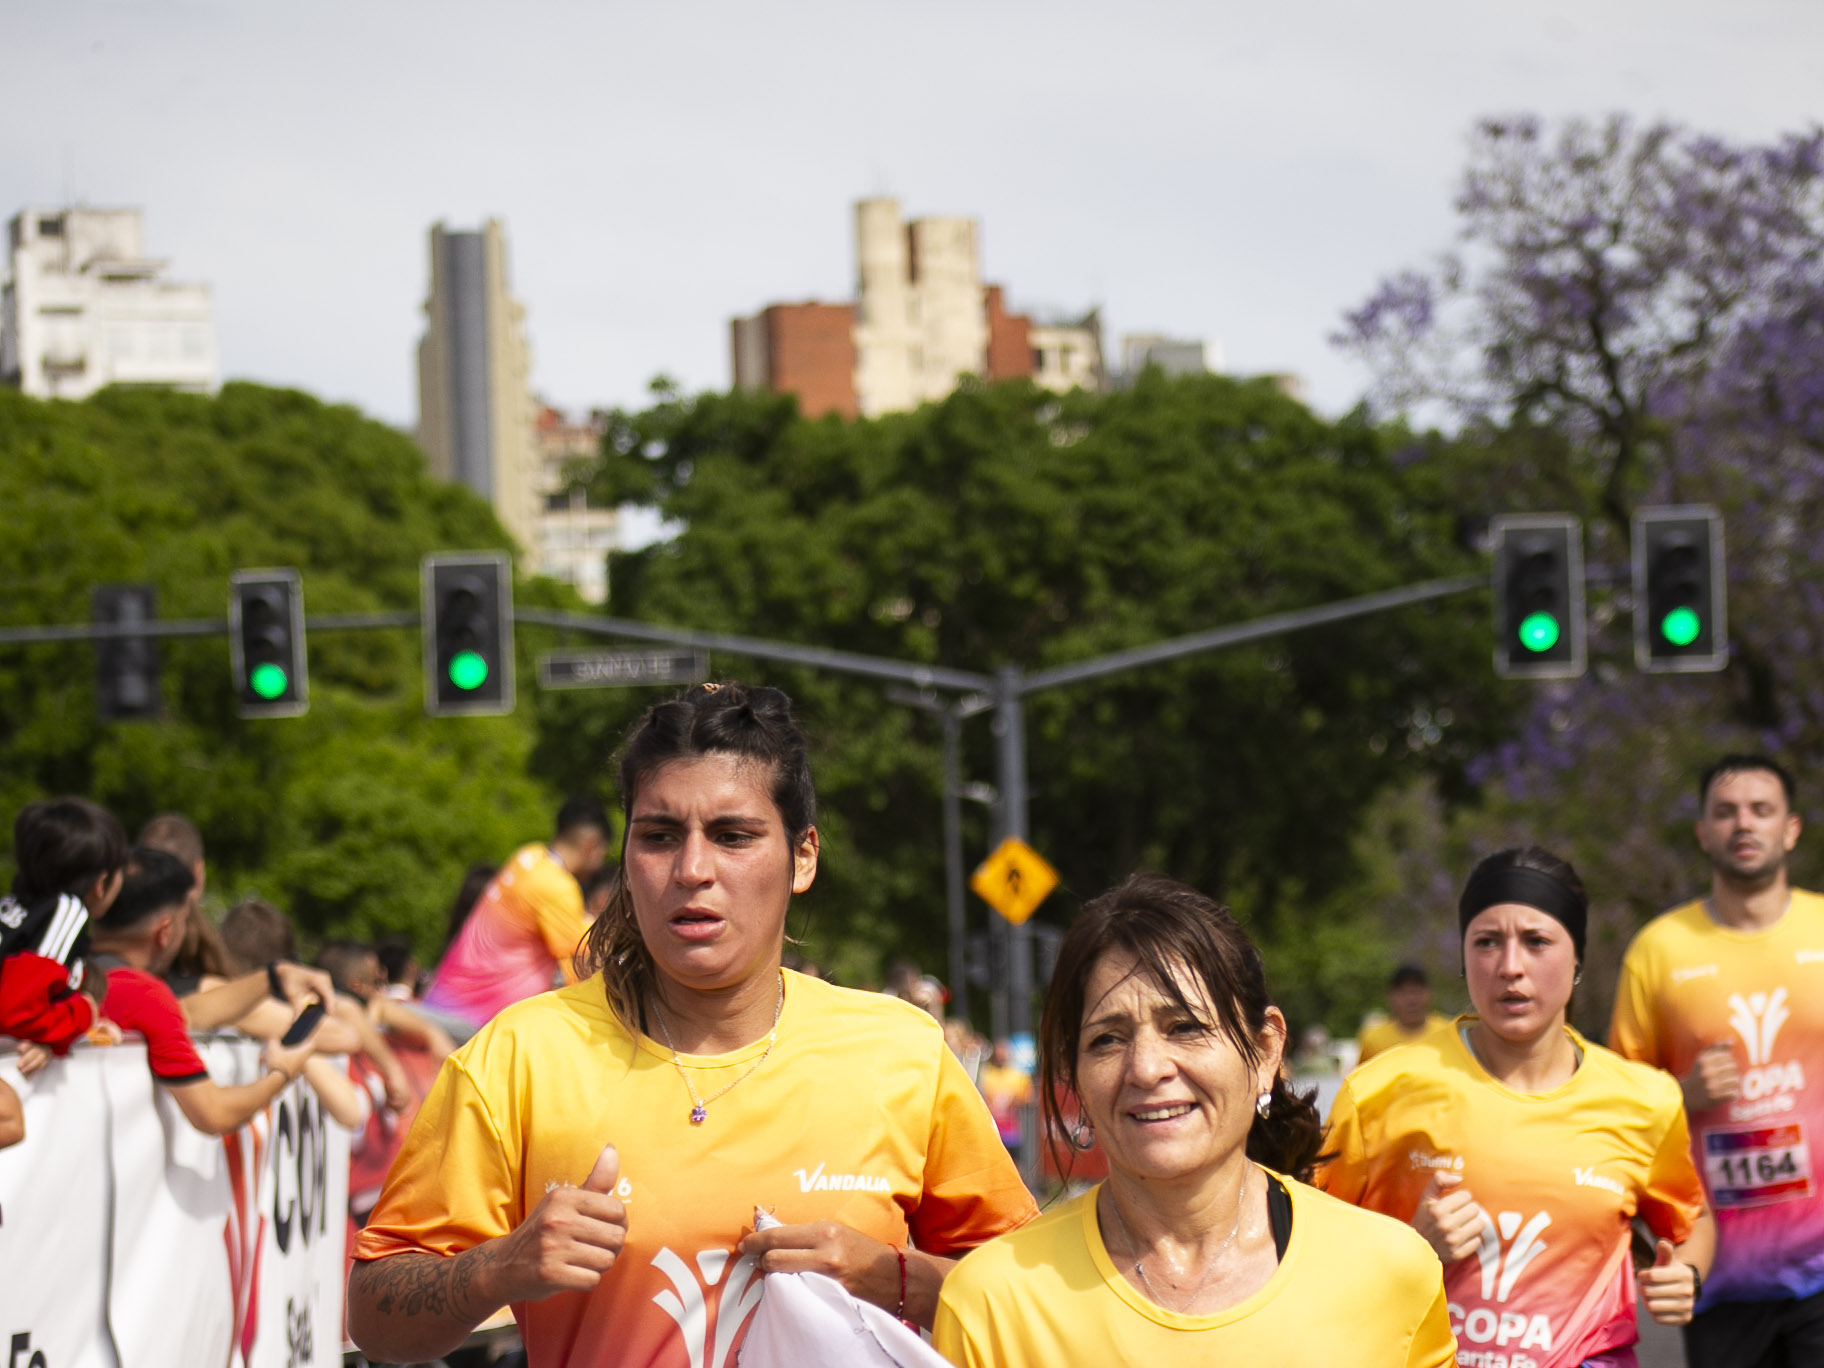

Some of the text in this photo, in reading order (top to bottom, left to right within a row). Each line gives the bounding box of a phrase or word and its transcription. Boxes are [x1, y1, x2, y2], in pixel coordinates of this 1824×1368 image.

[1740, 1060, 1805, 1101] OPA
[1453, 1156, 1465, 1170] 6
[1720, 1151, 1796, 1187] 1164
[616, 1177, 633, 1197] 6
